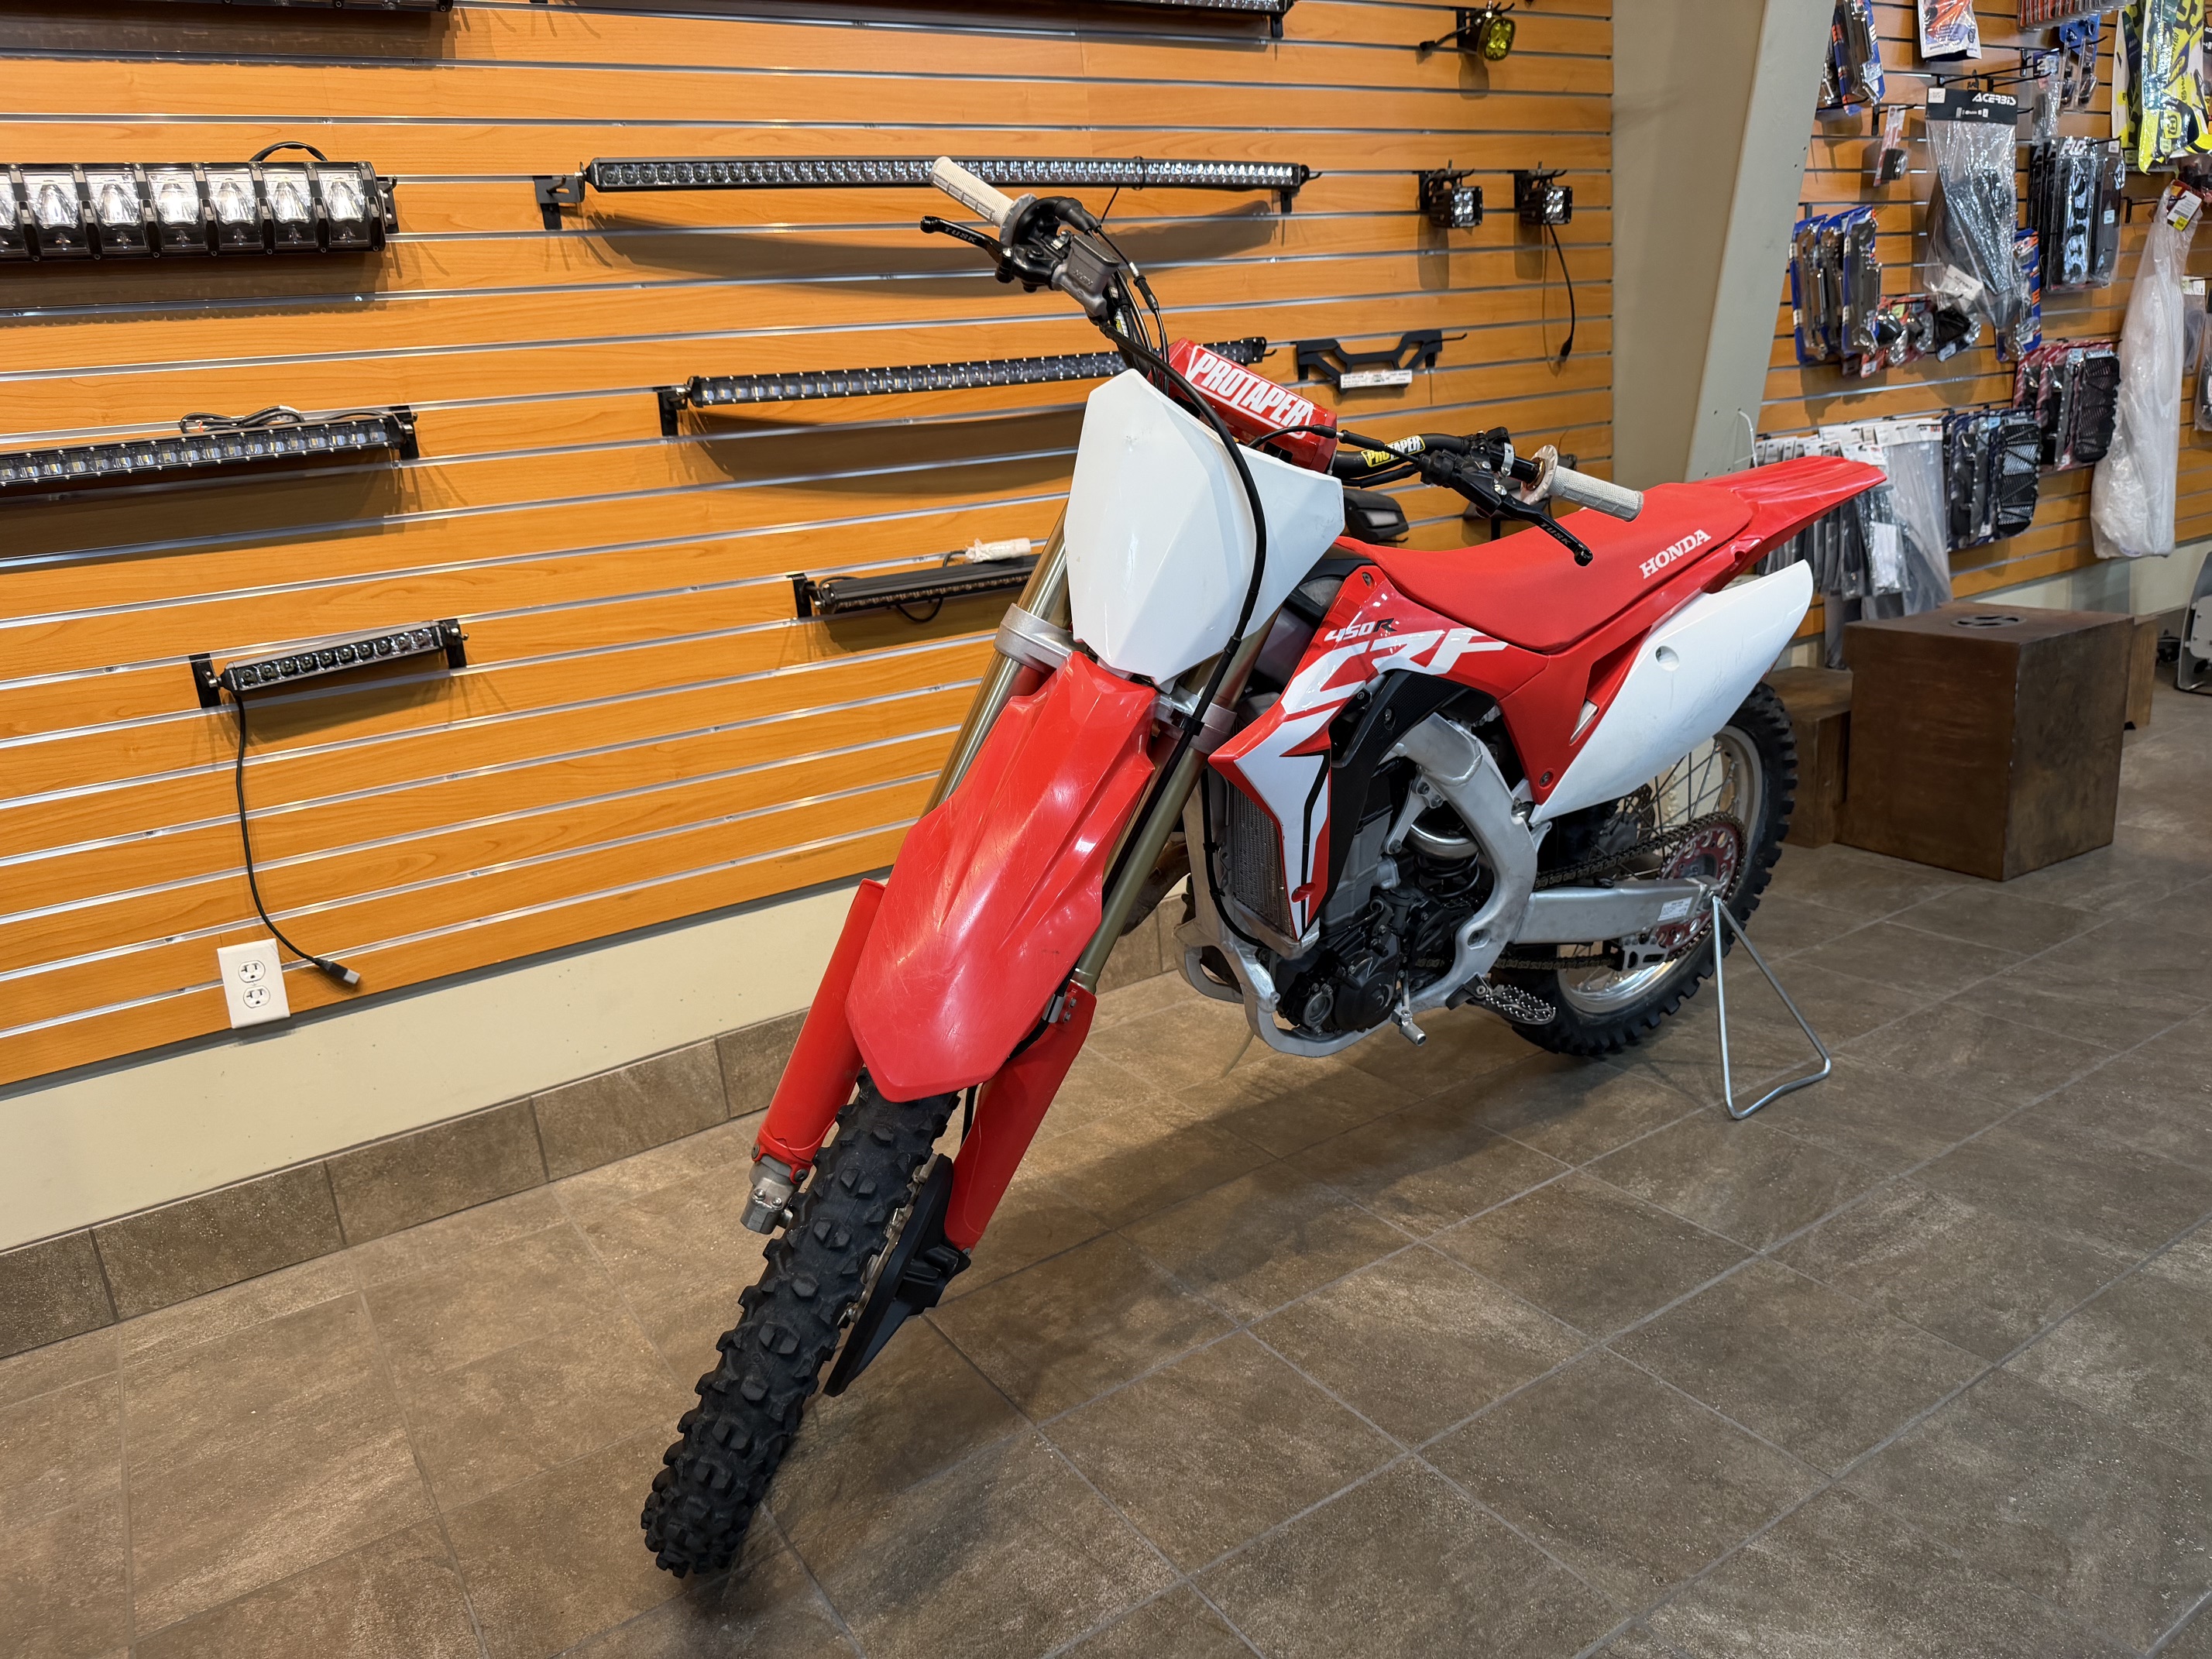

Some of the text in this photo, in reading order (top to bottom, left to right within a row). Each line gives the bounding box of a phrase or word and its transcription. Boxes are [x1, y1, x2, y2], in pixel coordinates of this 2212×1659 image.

[1971, 92, 2017, 106] ACERBIS
[945, 226, 977, 243] TUSK
[1187, 352, 1309, 428] PROTAPER
[1540, 522, 1571, 545] TUSK
[1639, 529, 1712, 579] HONDA
[1324, 617, 1398, 642] 450R
[1280, 627, 1509, 714] CRF
